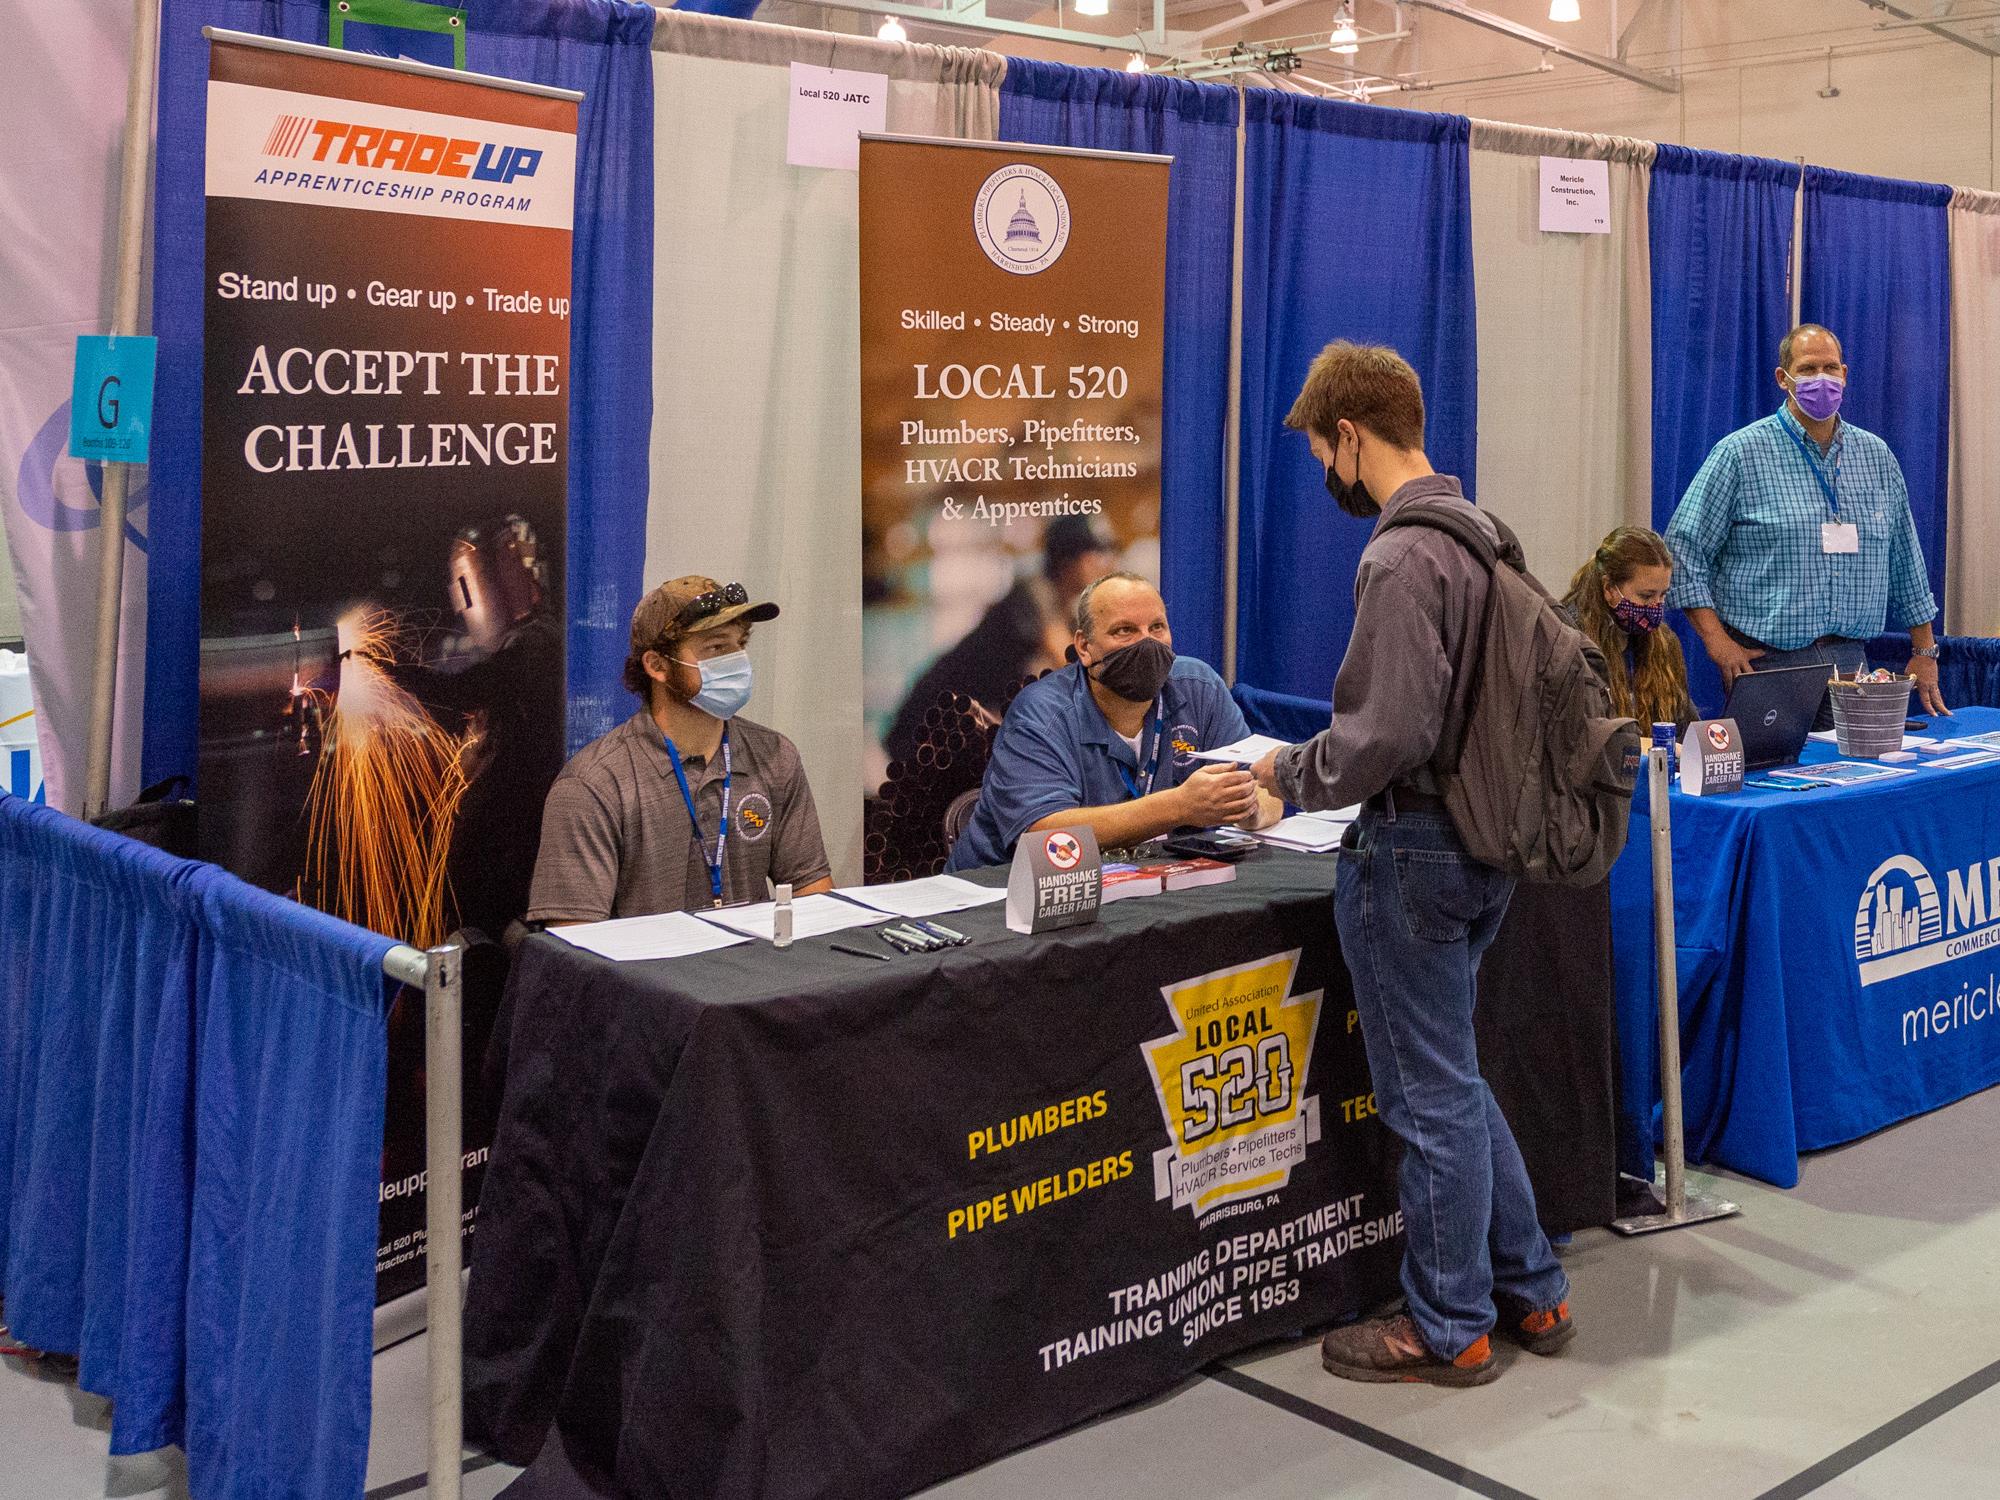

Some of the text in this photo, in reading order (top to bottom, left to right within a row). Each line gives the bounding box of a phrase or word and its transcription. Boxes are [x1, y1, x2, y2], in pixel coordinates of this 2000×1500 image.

[799, 87, 870, 104] Local 520 JATC
[255, 169, 532, 212] APPRENTICESHIP PROGRAM
[1551, 185, 1596, 196] Construction,
[1560, 175, 1584, 183] Mericle
[217, 272, 570, 320] Stand up Gear up Trade up
[901, 309, 1139, 338] Skilled Steady Strong
[237, 345, 560, 396] ACCEPT THE
[914, 363, 1128, 400] LOCAL 520
[98, 376, 120, 429] G
[244, 422, 557, 473] CHALLENGE
[900, 418, 1140, 450] Plumbers, Pipefitters,
[904, 455, 1137, 484] HVACR Technicians
[941, 493, 1102, 527] & Apprentices
[1704, 751, 1742, 763] HANDSHAKE
[1705, 760, 1742, 776] FREE
[1705, 773, 1742, 785] CAREER FAIR
[743, 809, 764, 827] 520
[1038, 868, 1098, 890] HANDSHAKE
[1039, 881, 1097, 907] FREE
[1038, 899, 1097, 918] CAREER FAIR
[1185, 984, 1279, 1021] United Association
[1902, 973, 2000, 1046] mericl
[1195, 1006, 1273, 1052] LOCAL
[1180, 1032, 1294, 1144] 520
[968, 1089, 1108, 1160] PLUMBERS
[1181, 1127, 1296, 1178] Plumbers Pipefitters
[1220, 1154, 1266, 1177] Service
[1269, 1143, 1302, 1163] Techs
[947, 1150, 1134, 1240] PIPE WELDERS
[1200, 1194, 1280, 1230] HARRISBURG, PA
[393, 1235, 411, 1250] 520
[1108, 1193, 1364, 1316] TRAINING DEPARTMENT
[1038, 1209, 1405, 1372] TRAINING UNION PIPE TRADESME
[1182, 1278, 1301, 1347] SINCE 1953
